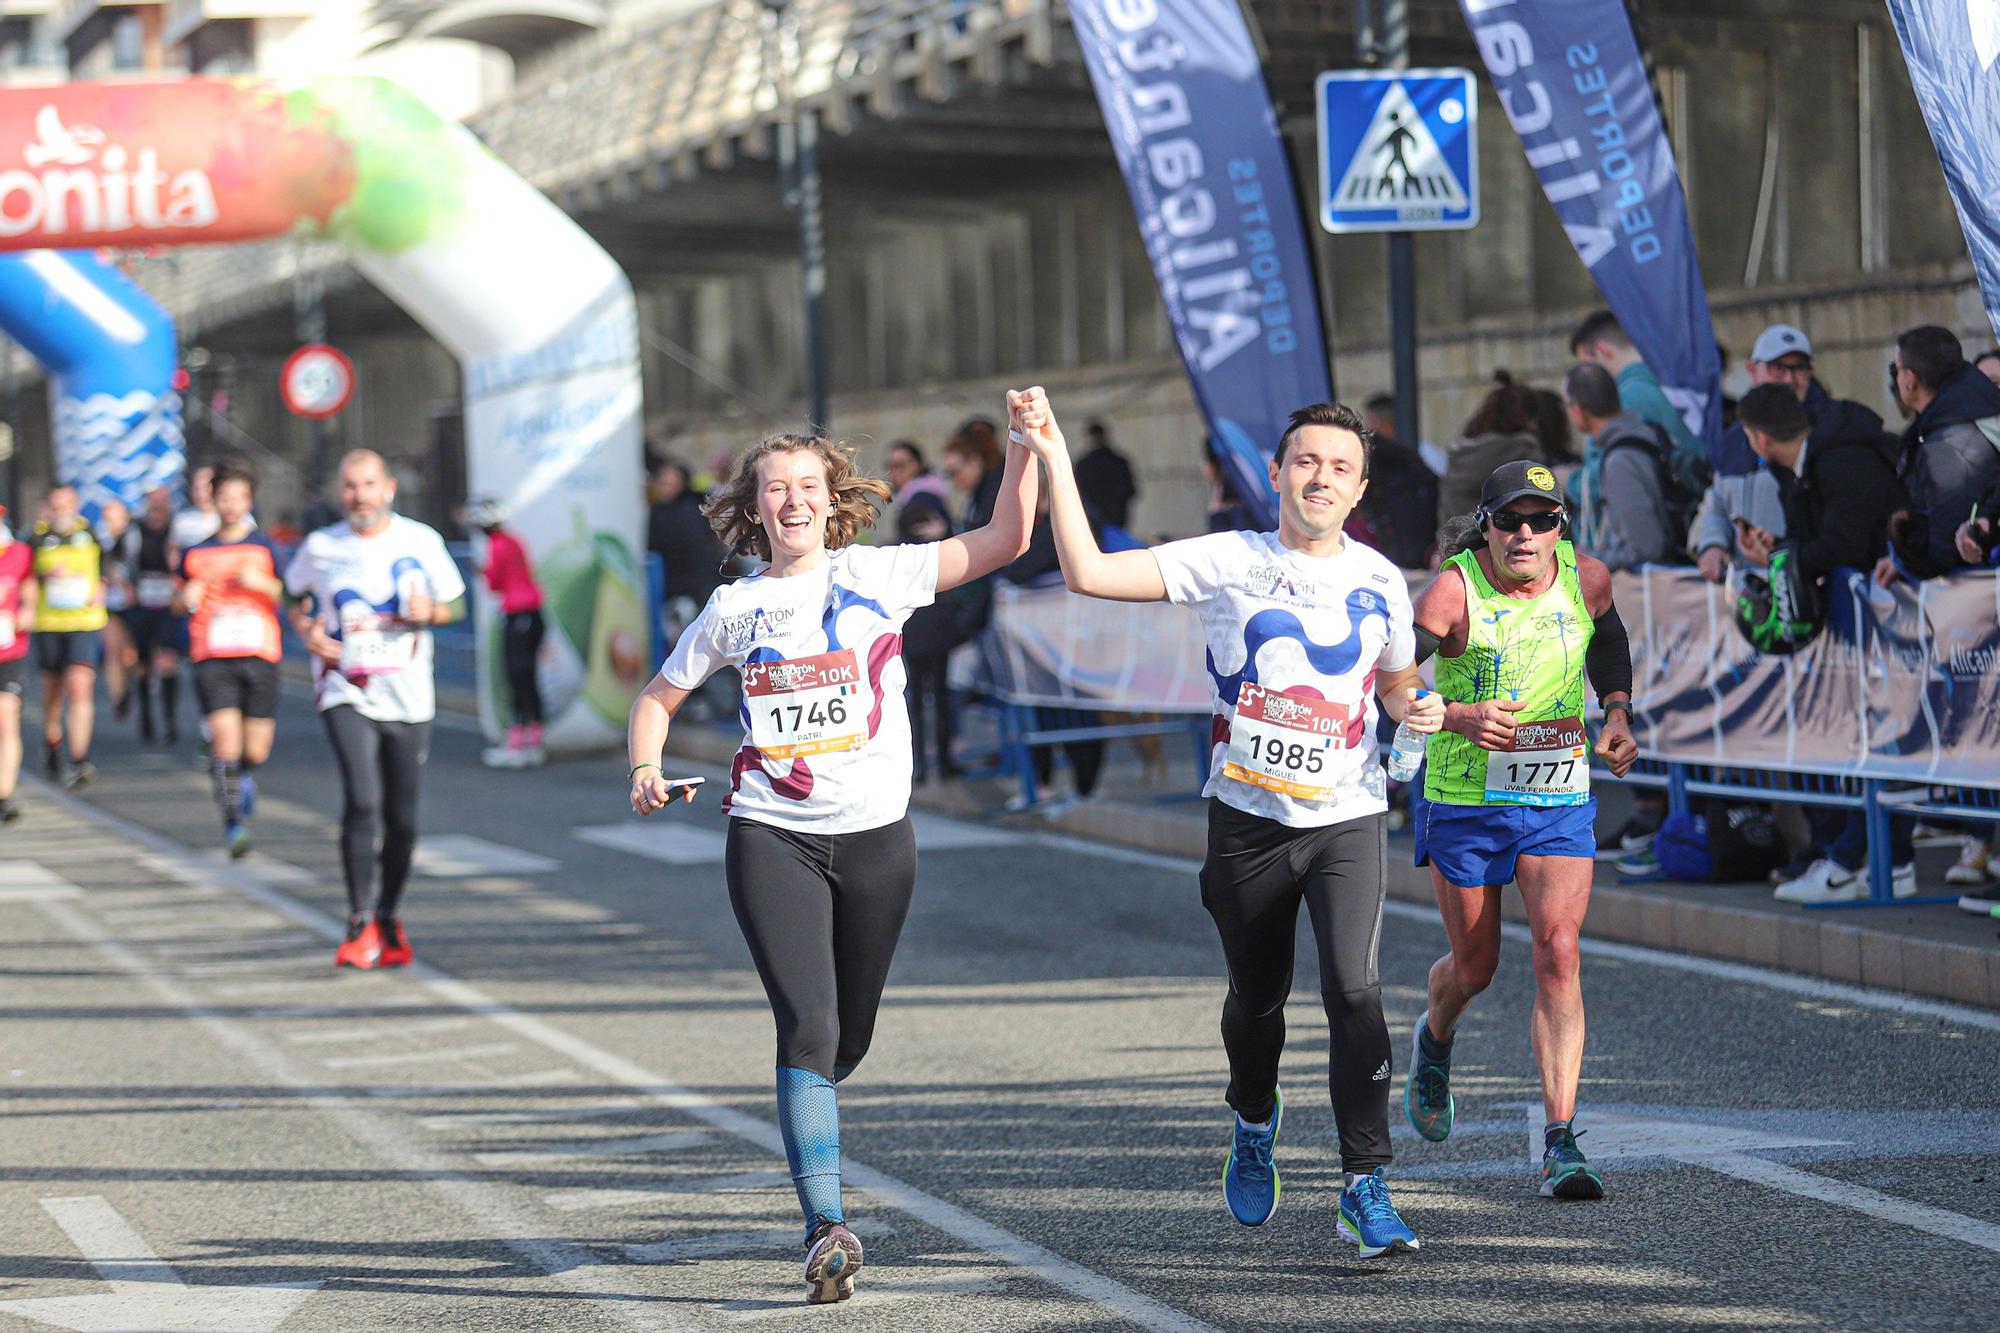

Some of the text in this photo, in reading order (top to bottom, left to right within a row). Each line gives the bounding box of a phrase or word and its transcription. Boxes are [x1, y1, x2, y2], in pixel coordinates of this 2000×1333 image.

[819, 664, 855, 685] 10K
[770, 698, 847, 733] 1746
[1312, 716, 1344, 735] 10K
[797, 731, 822, 741] PATRI
[1558, 729, 1582, 746] 10K
[1250, 734, 1325, 774] 1985
[1264, 766, 1298, 781] MIGUEL
[1507, 760, 1575, 784] 1777
[1504, 784, 1574, 794] UVAS FERRANDIZ
